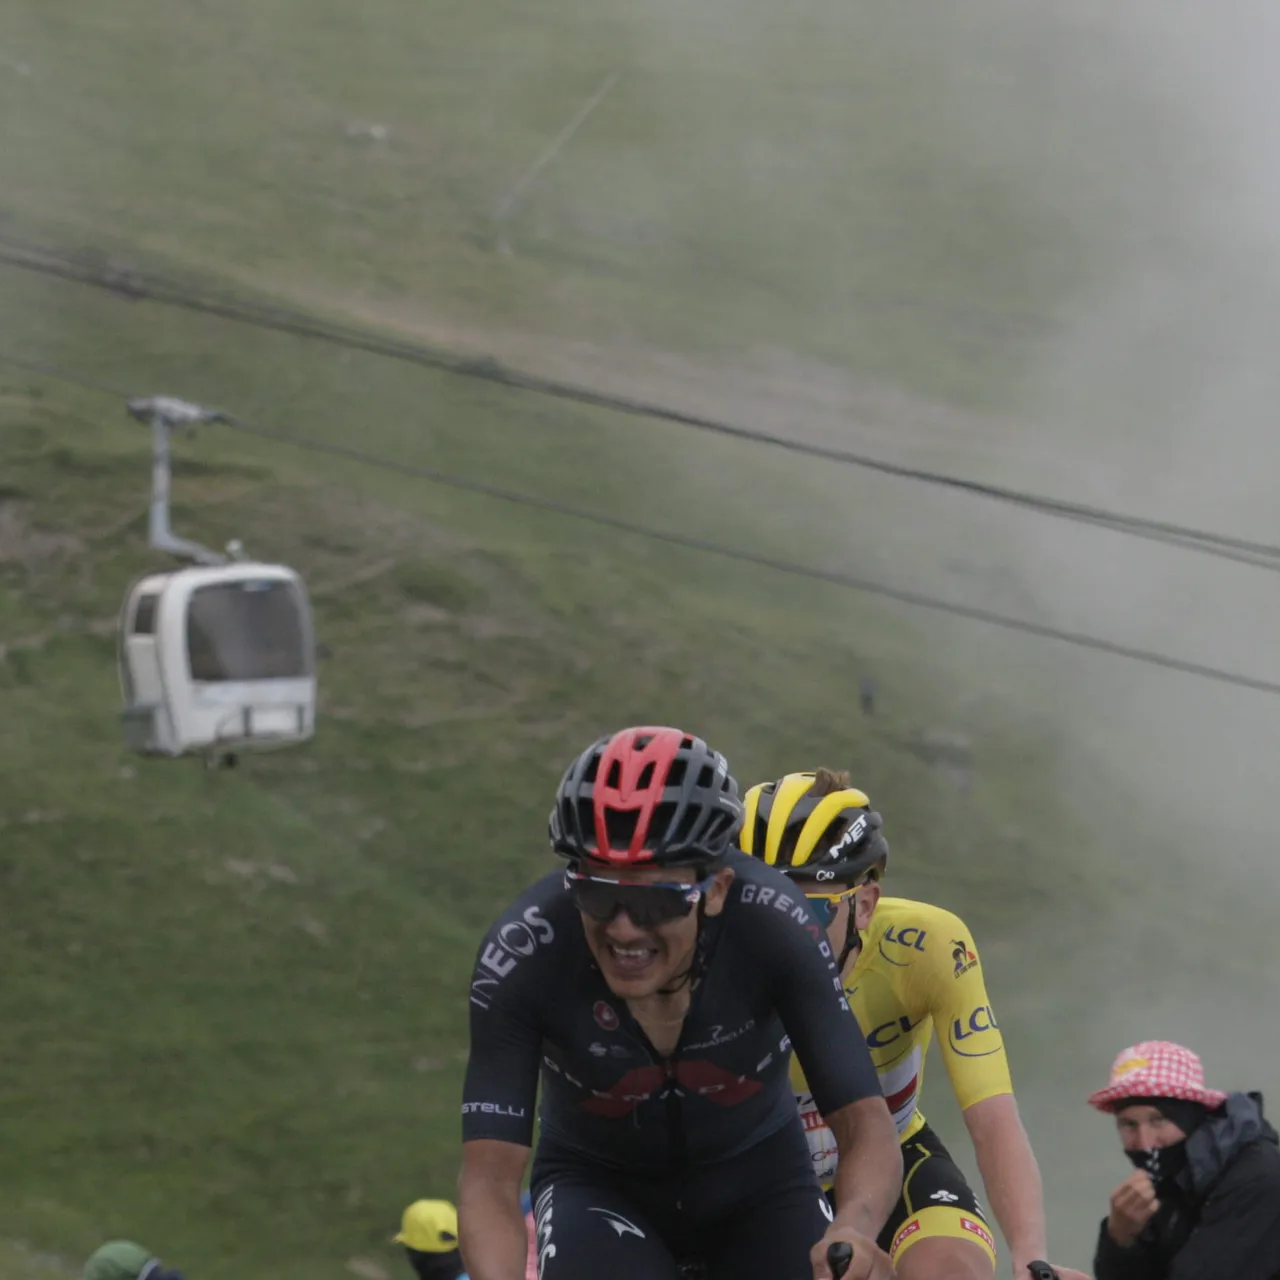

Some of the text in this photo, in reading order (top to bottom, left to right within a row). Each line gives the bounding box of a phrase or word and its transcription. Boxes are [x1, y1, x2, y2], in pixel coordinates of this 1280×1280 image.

[829, 814, 867, 859] MET
[469, 905, 555, 1010] INEOS
[884, 925, 927, 953] LCL
